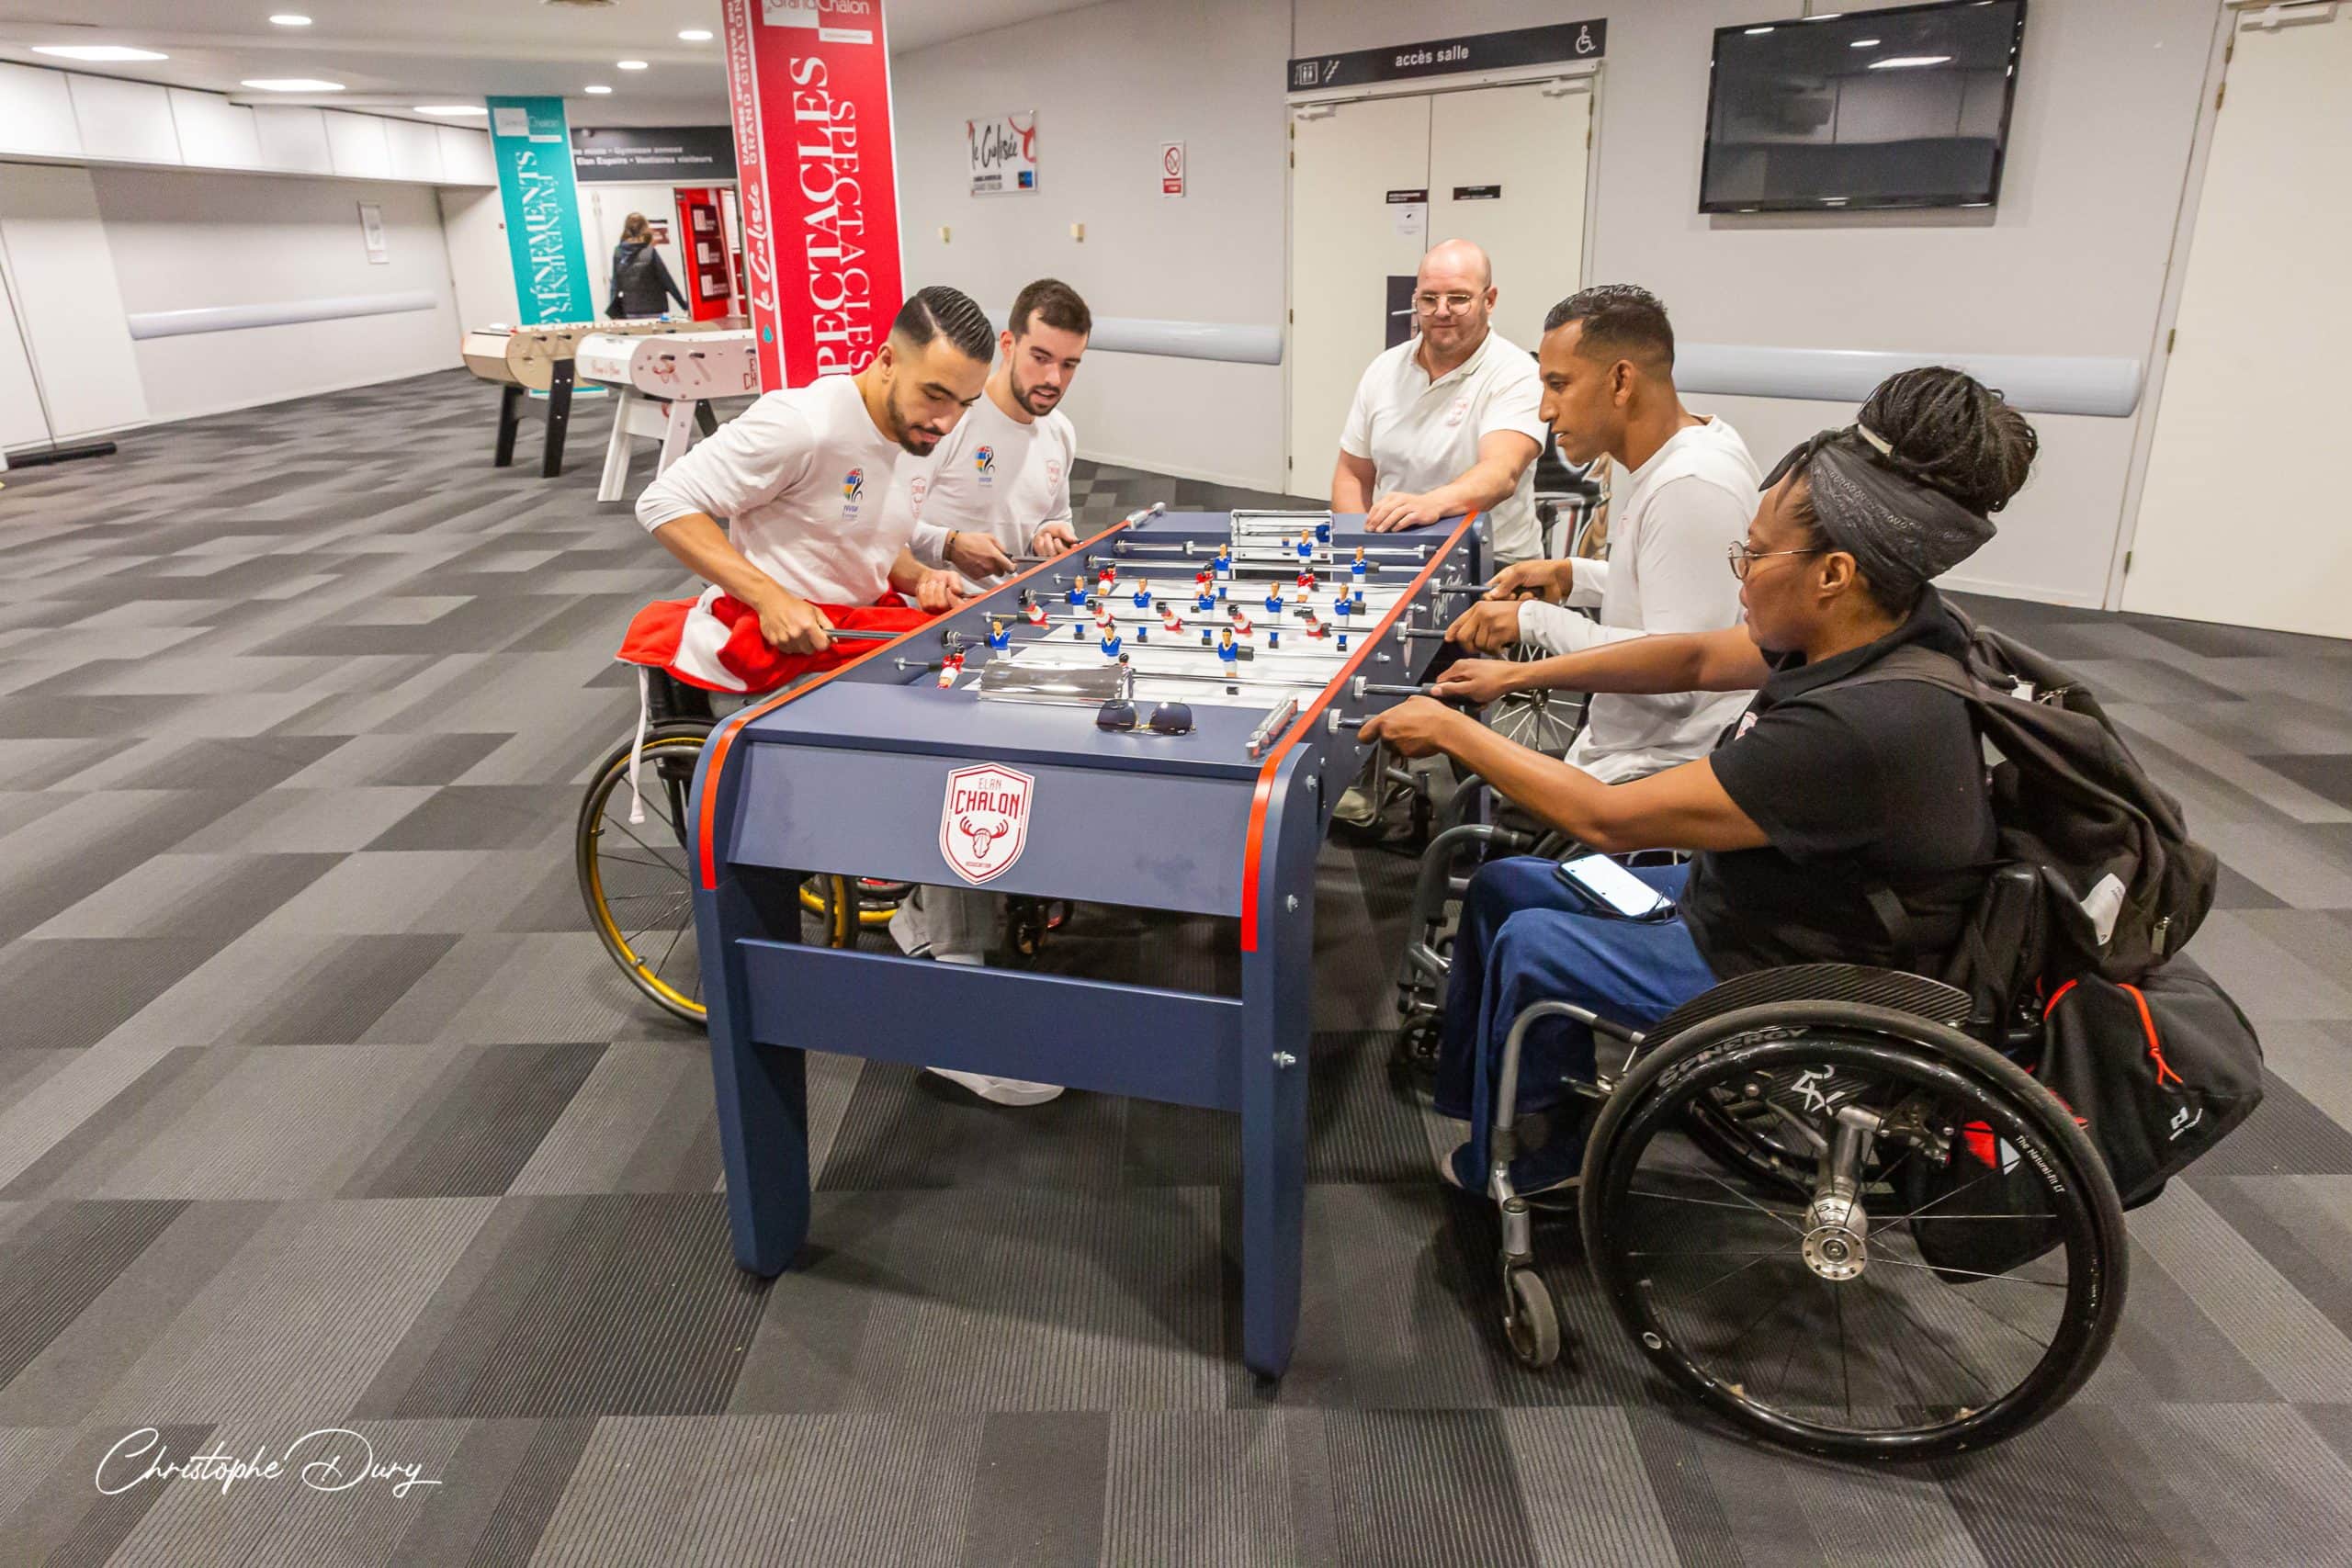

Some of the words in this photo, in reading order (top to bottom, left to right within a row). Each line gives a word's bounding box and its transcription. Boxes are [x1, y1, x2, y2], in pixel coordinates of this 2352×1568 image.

[1395, 47, 1432, 67] accès
[1436, 46, 1469, 62] salle
[743, 94, 757, 165] GRAND
[746, 181, 772, 283] Colisée
[789, 56, 851, 377] PECTACLES
[956, 790, 1020, 819] CHALON
[978, 778, 1002, 790] ELAN
